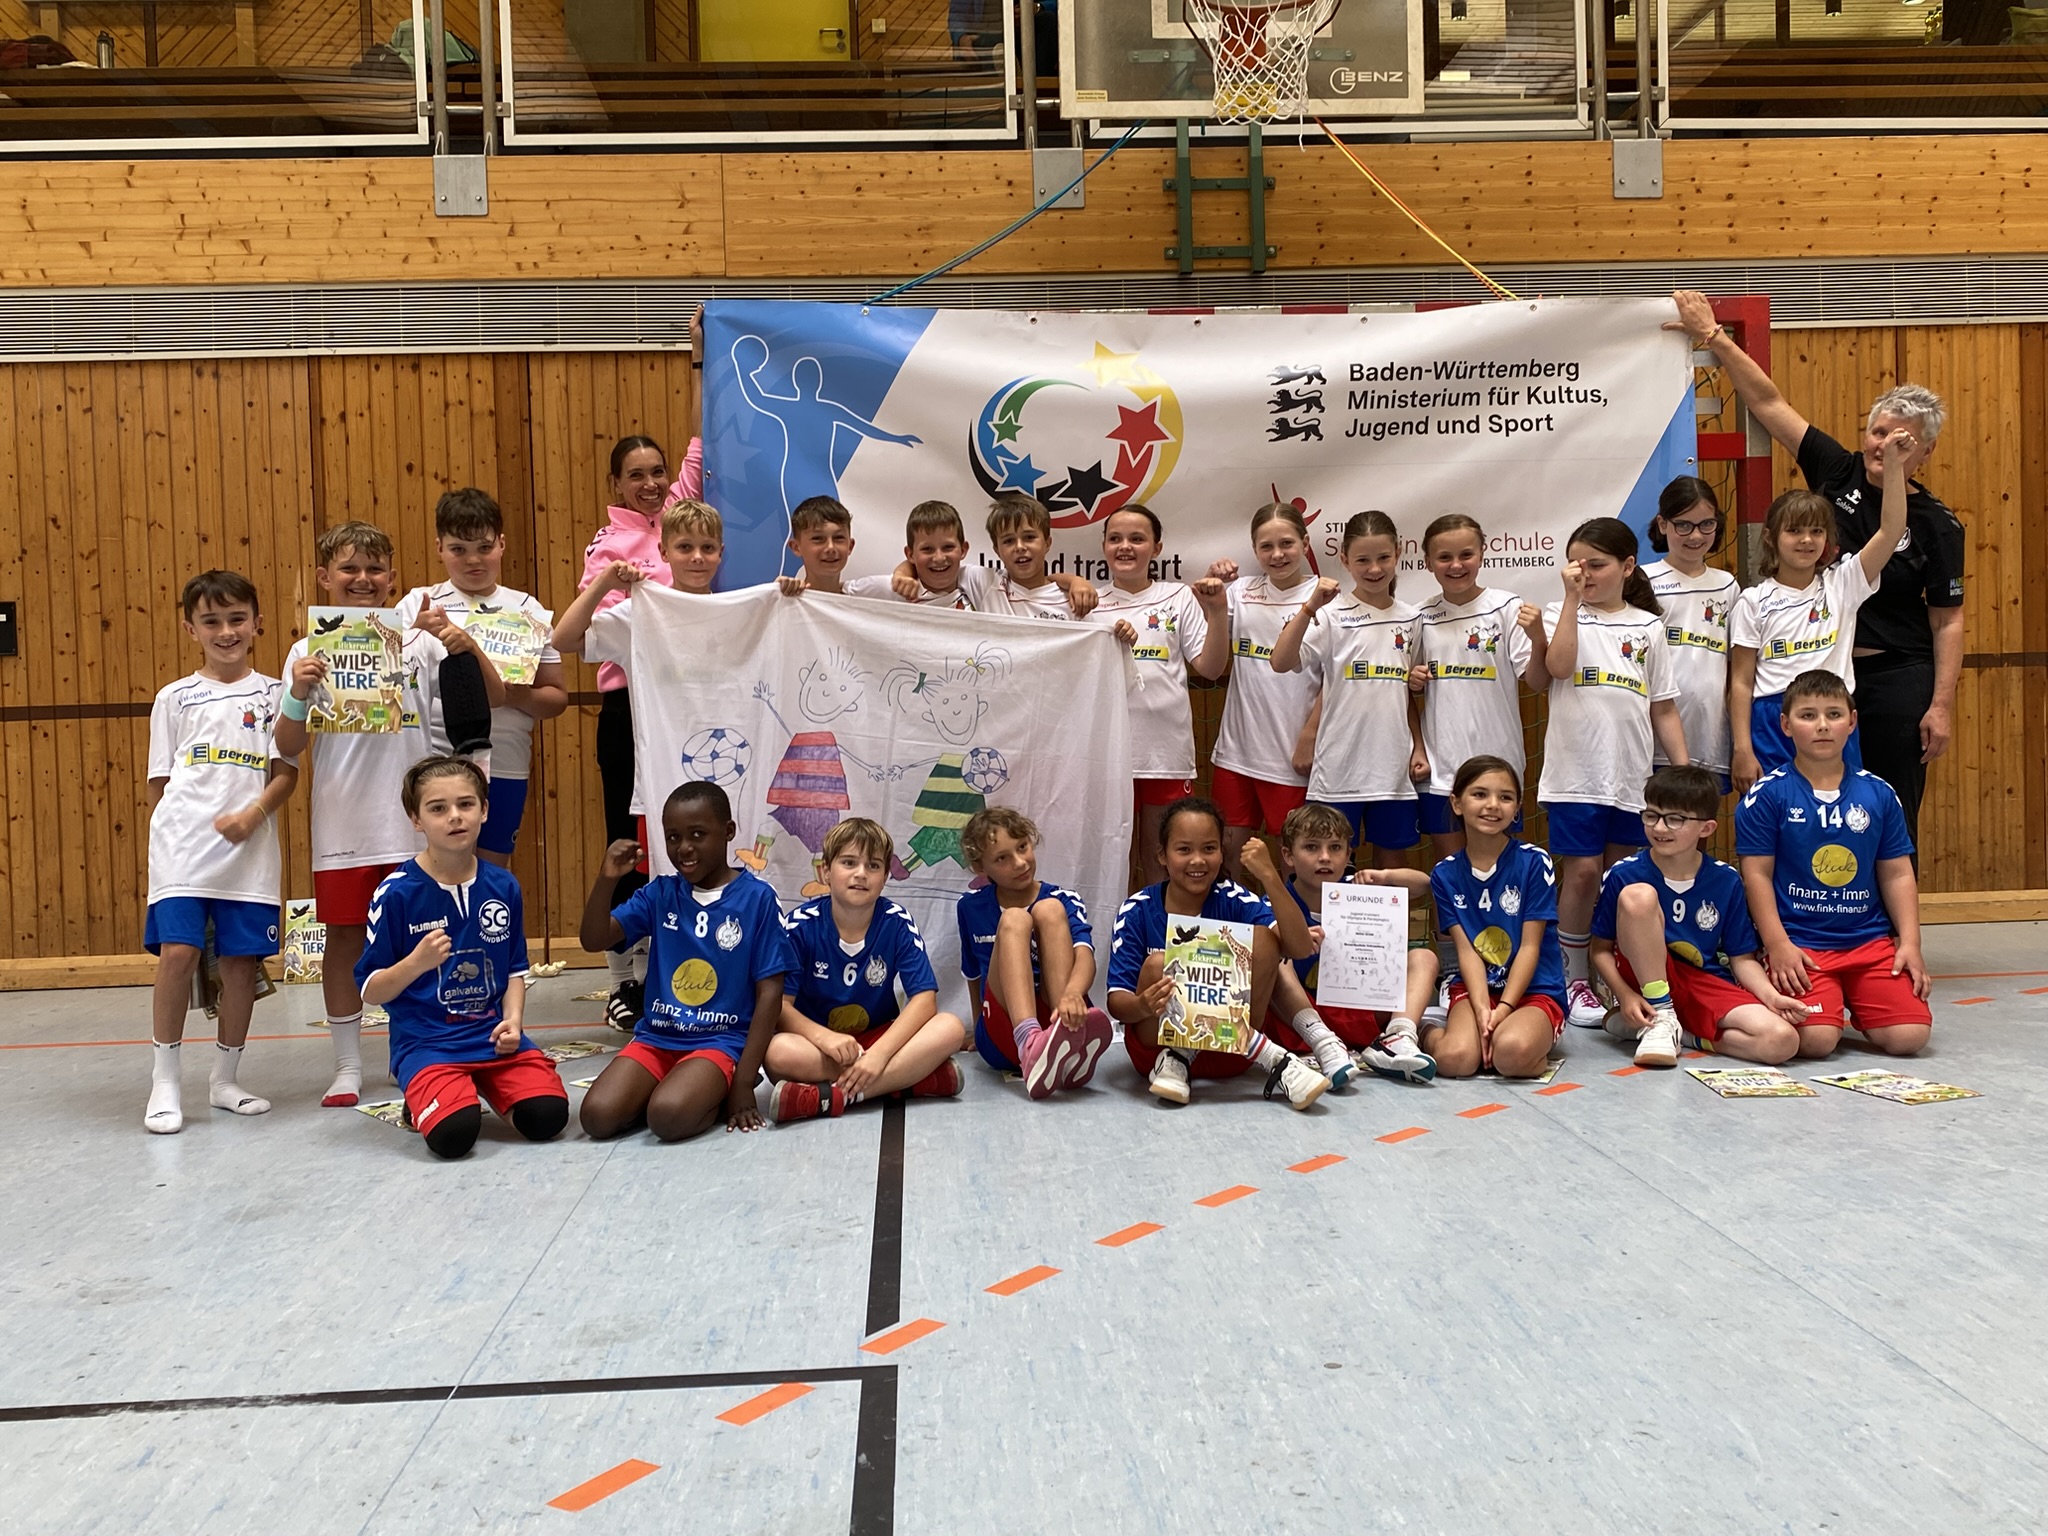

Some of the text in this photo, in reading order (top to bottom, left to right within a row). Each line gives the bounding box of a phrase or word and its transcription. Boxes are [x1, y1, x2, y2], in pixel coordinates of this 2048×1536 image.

[1349, 358, 1579, 382] Baden-Württemberg
[1347, 385, 1608, 410] Ministerium für Kultus,
[1345, 413, 1554, 441] Jugend und Sport
[1074, 554, 1183, 581] traert
[1401, 559, 1414, 571] IN
[1653, 582, 1682, 591] hlsport
[1422, 611, 1447, 621] hlsport
[485, 628, 527, 647] WILDE
[1793, 634, 1833, 651] Berger
[482, 639, 521, 657] TIERE
[1131, 648, 1162, 658] rger
[332, 652, 382, 671] WILDE
[1445, 664, 1486, 676] Berger
[331, 671, 378, 690] TIERE
[1606, 673, 1643, 690] Berger
[217, 749, 265, 766] Berger
[1816, 804, 1844, 829] 14
[1346, 895, 1384, 904] URKUNDE
[1478, 888, 1493, 912] 4
[1787, 883, 1828, 901] finanz
[482, 907, 509, 929] SG
[1672, 898, 1686, 923] 9
[409, 915, 449, 935] hummel
[694, 911, 709, 938] 8
[301, 928, 327, 942] WILD
[300, 942, 325, 955] TIER
[843, 962, 858, 987] 6
[1186, 966, 1232, 987] WILDE
[444, 985, 485, 1000] galvatec
[1184, 984, 1228, 1006] TIERE
[696, 1008, 738, 1024] immo
